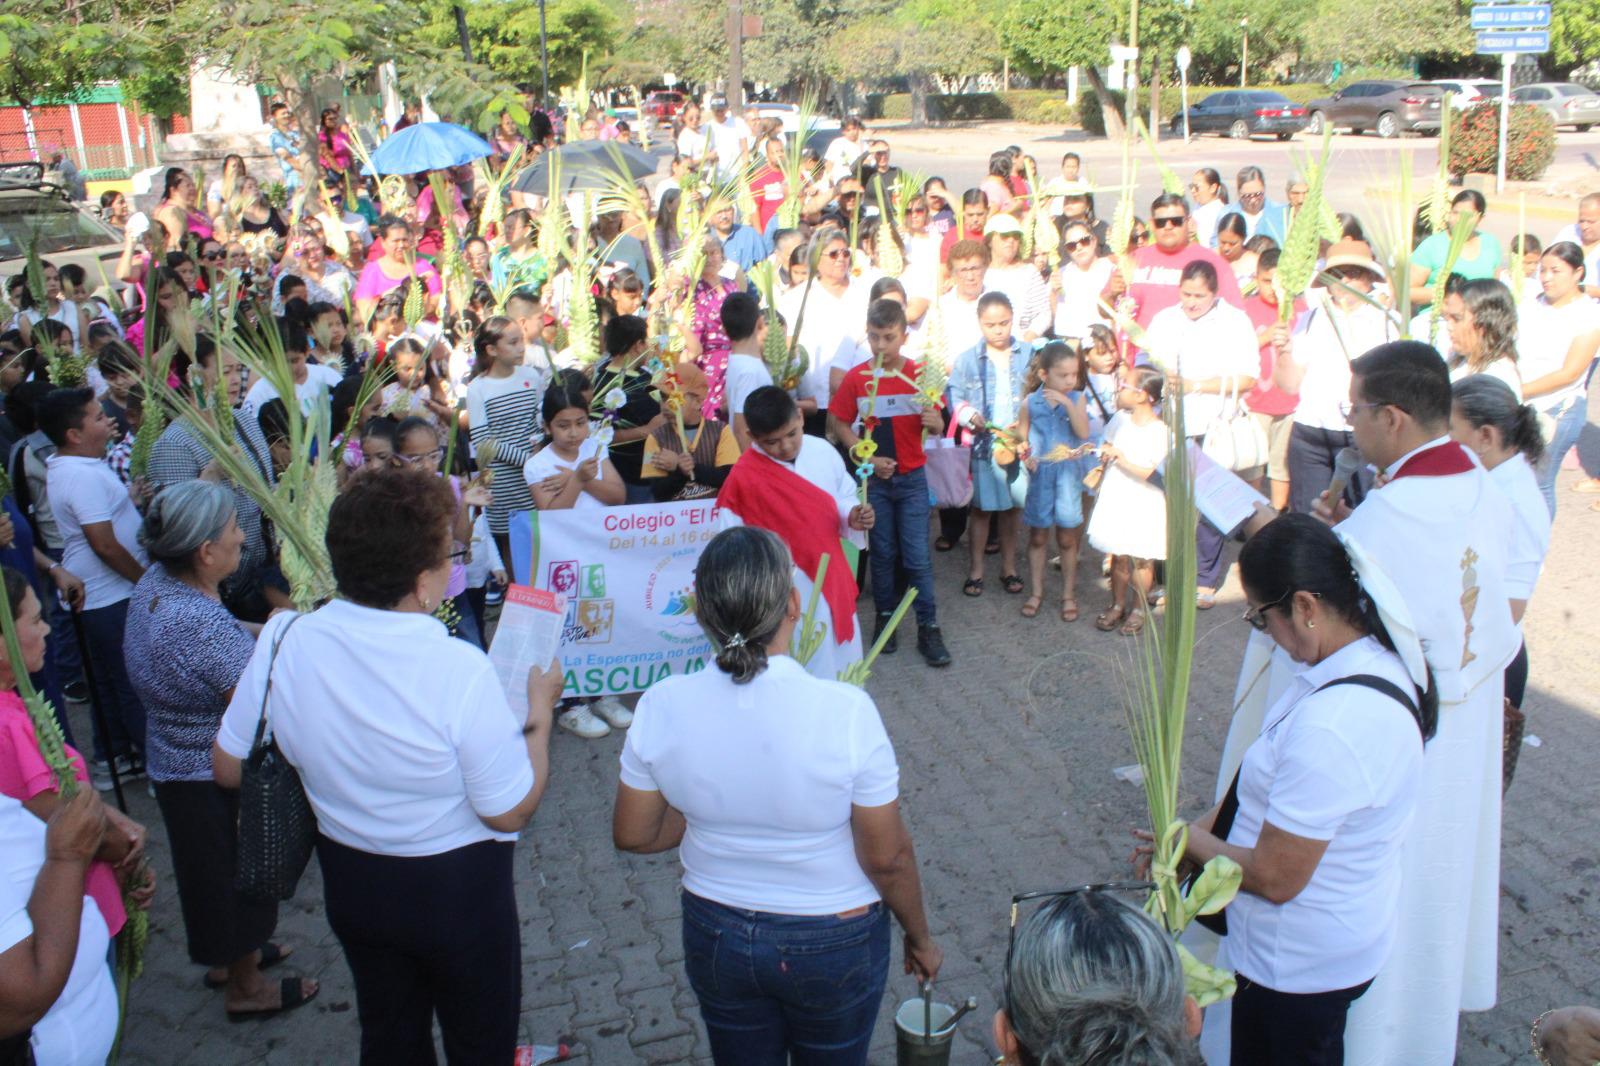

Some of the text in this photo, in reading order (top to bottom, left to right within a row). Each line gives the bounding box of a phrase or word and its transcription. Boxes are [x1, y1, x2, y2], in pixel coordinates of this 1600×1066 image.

[604, 512, 675, 532] Colegio
[609, 535, 635, 550] Del
[641, 535, 657, 547] 14
[662, 532, 675, 546] al
[680, 530, 697, 544] 16
[564, 655, 582, 666] La
[587, 650, 664, 667] Esperanza
[667, 648, 683, 658] no
